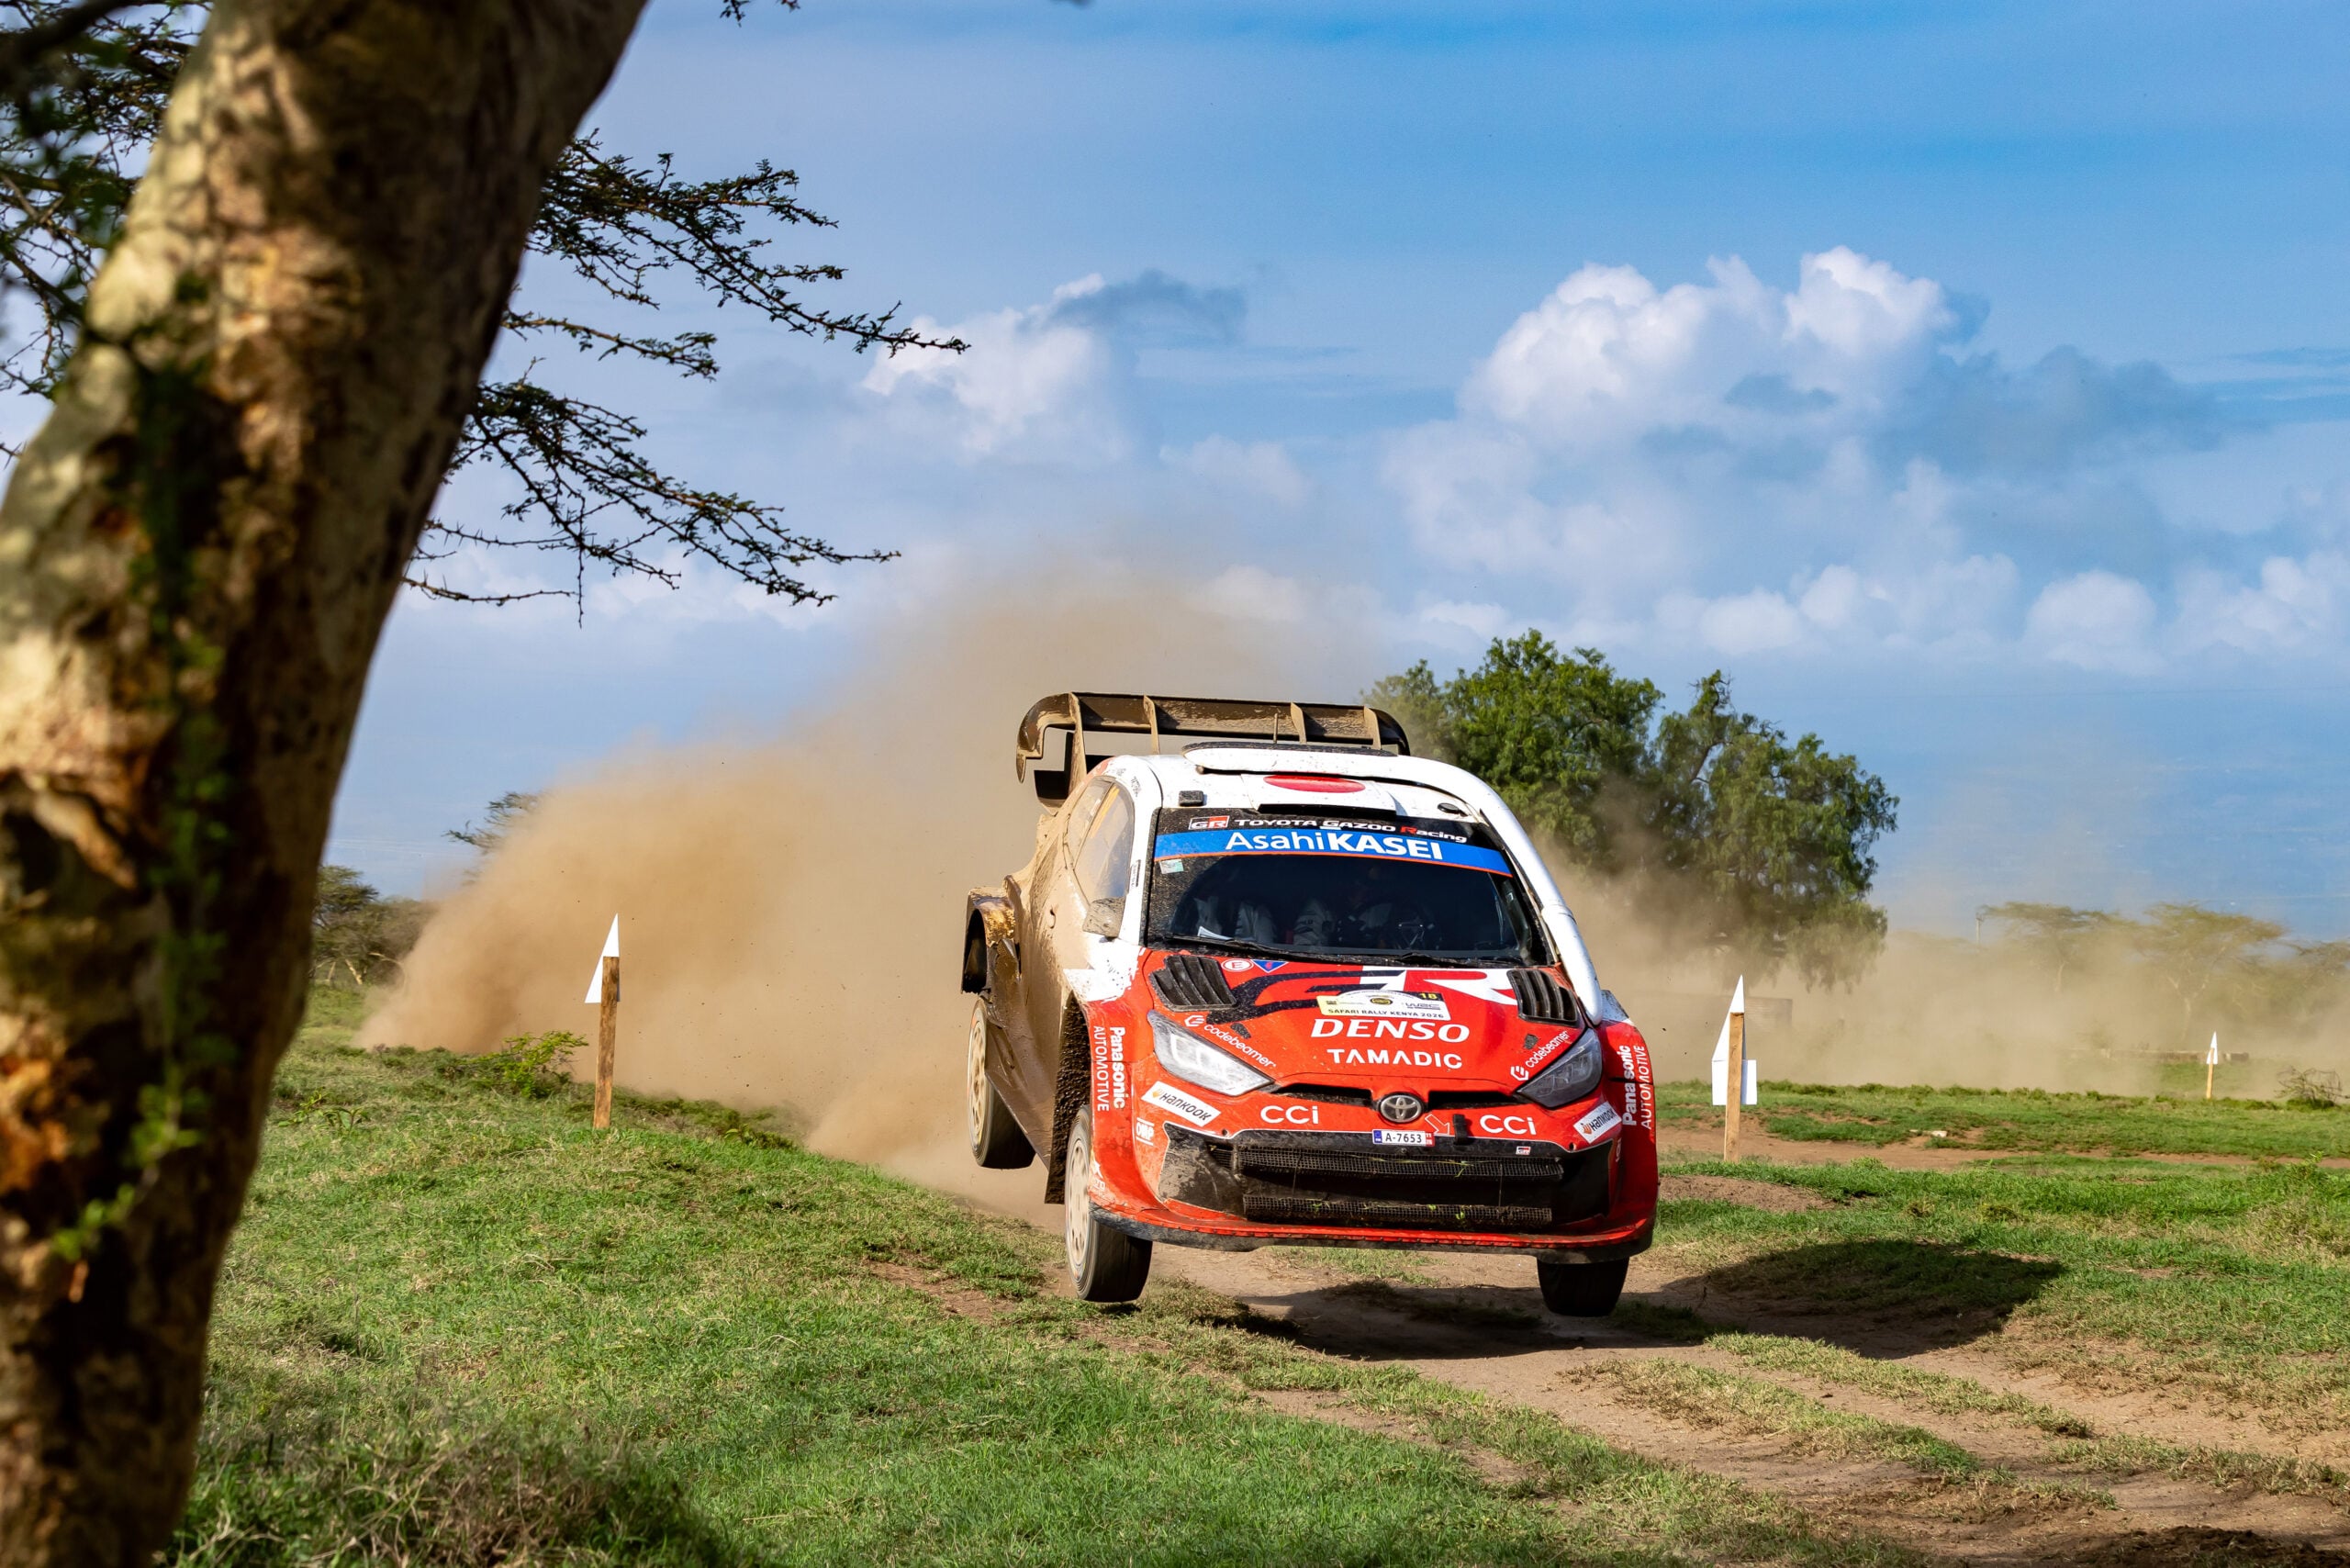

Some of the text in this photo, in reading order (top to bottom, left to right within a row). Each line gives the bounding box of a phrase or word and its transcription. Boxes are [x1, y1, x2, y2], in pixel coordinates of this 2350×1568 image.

[1191, 819, 1227, 829] GR
[1322, 820, 1396, 832] GAZOO
[1400, 826, 1468, 844] Racing
[1204, 1024, 1275, 1067] codebeamer
[1311, 1018, 1470, 1043] DENSO
[1525, 1030, 1570, 1069] codebeamer
[1093, 1025, 1110, 1112] AUTOMOTIVE
[1110, 1026, 1129, 1109] Panasonic
[1326, 1048, 1463, 1070] TAMADIC
[1617, 1045, 1638, 1126] Panasonic
[1633, 1045, 1653, 1130] AUTOMOTIVE
[1384, 1132, 1422, 1143] A-7653
